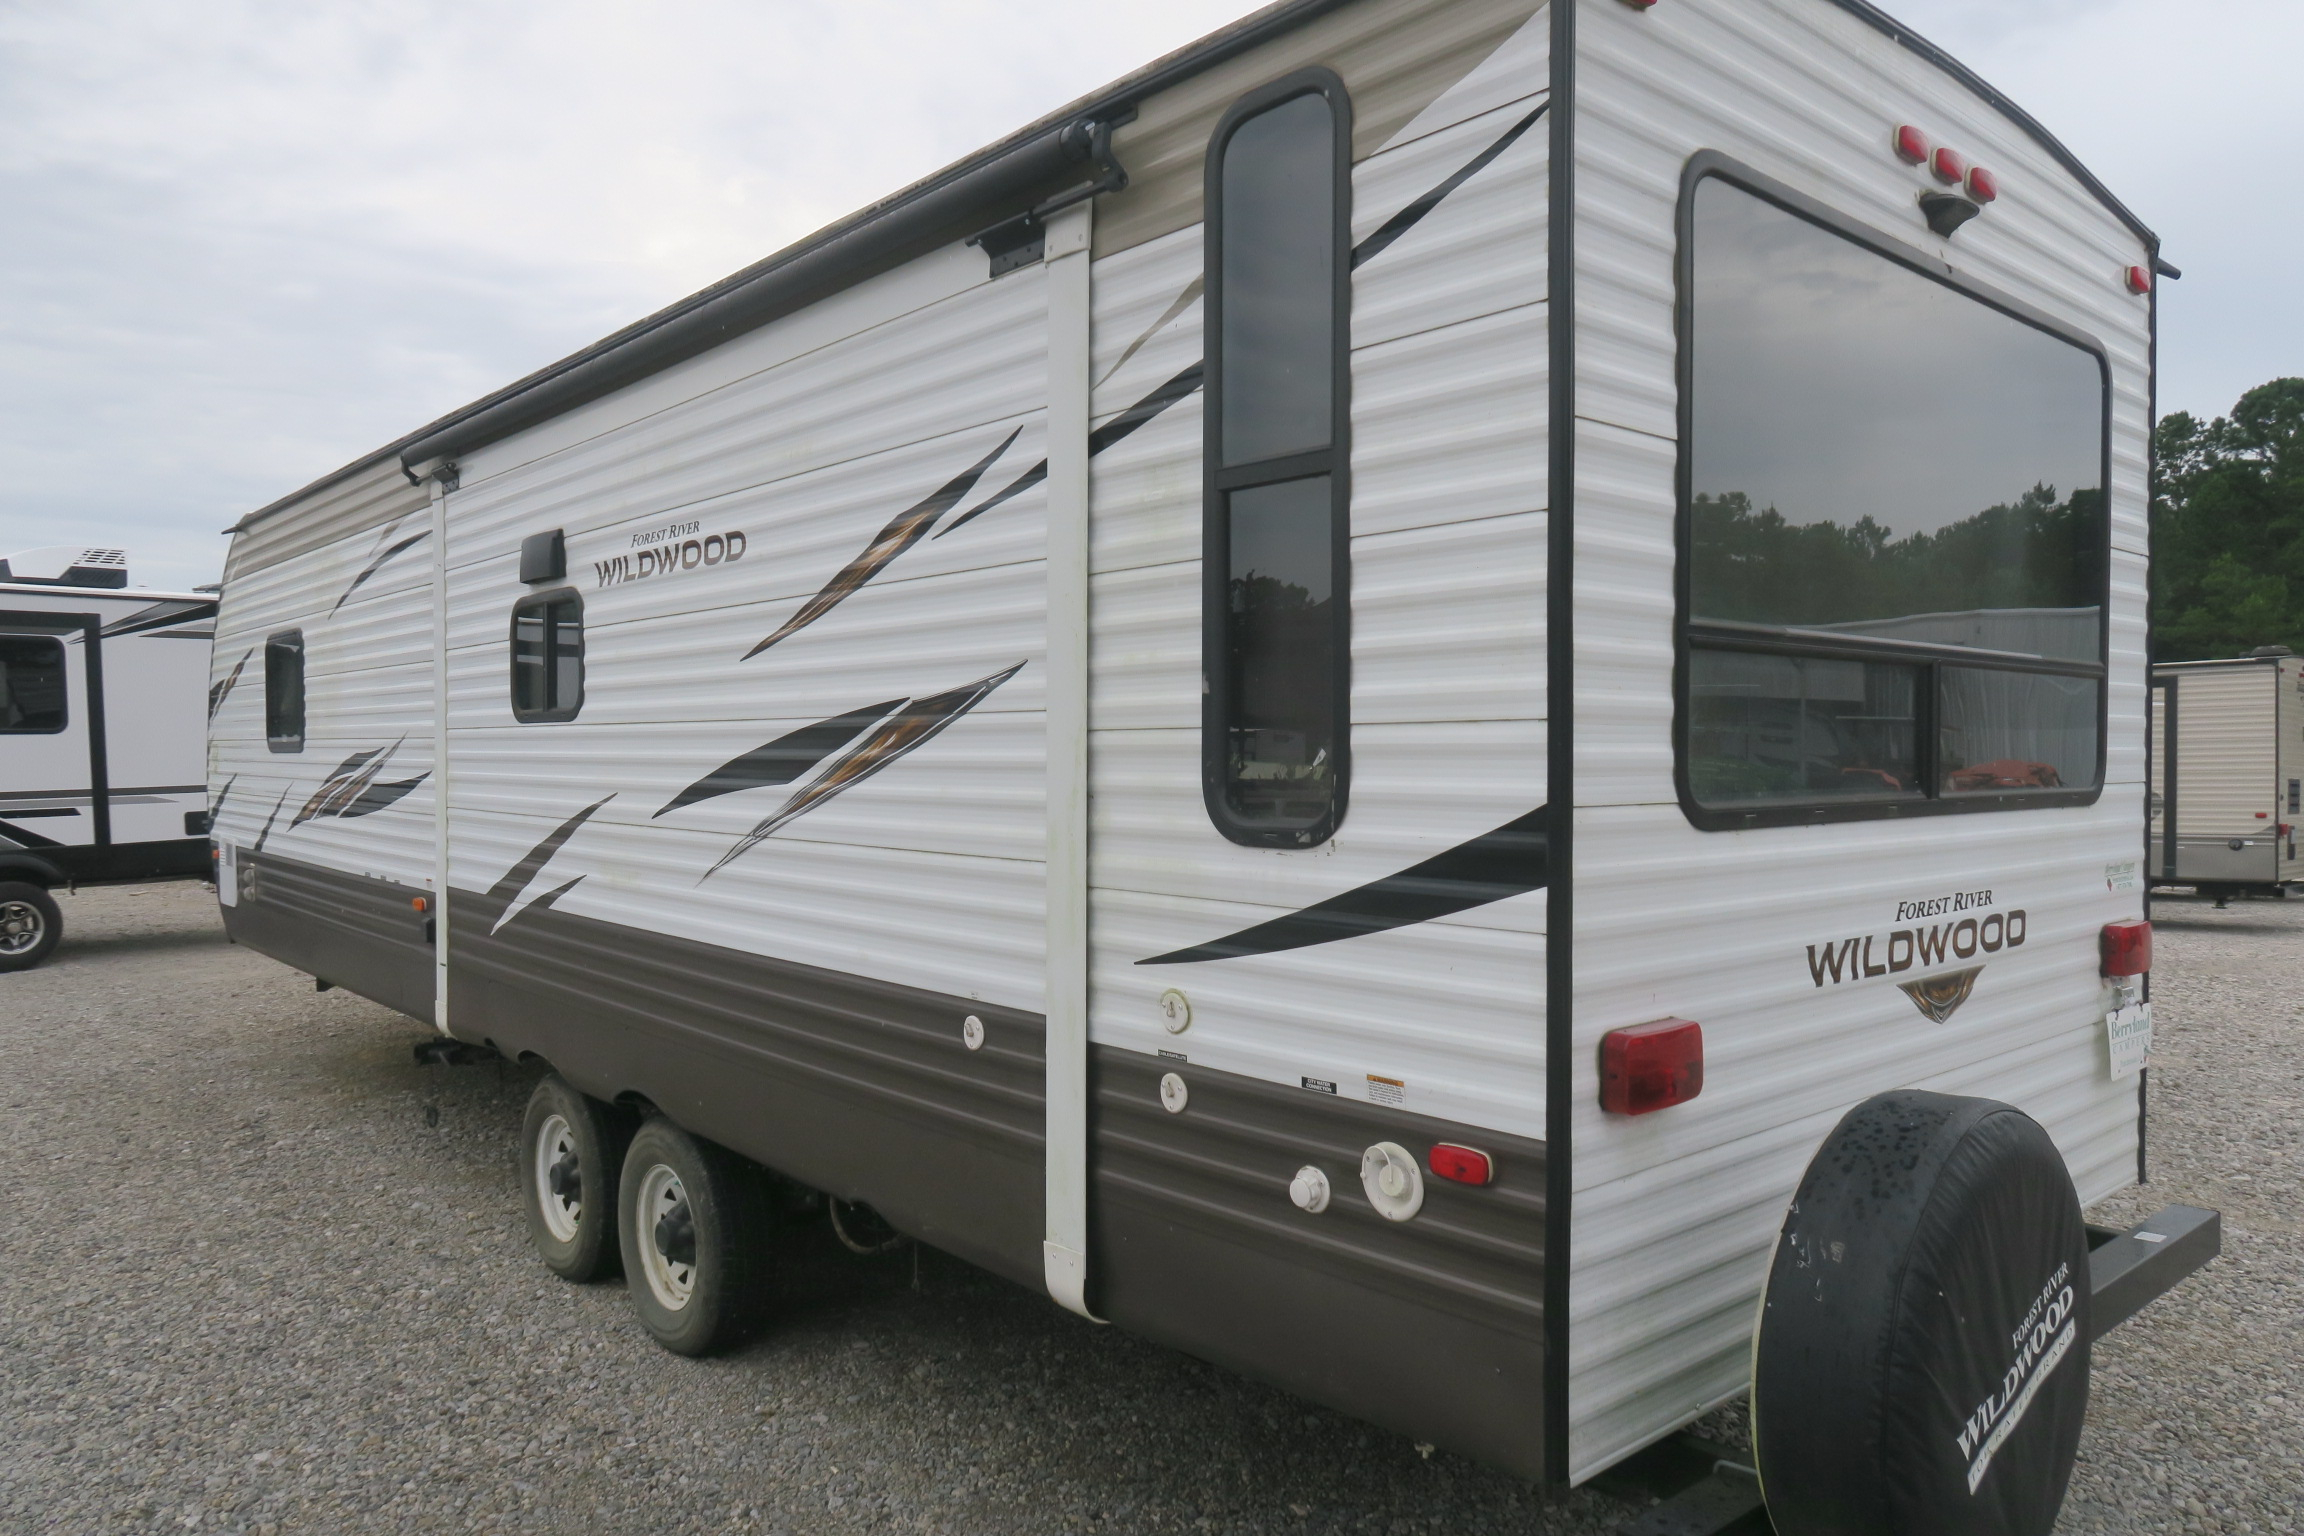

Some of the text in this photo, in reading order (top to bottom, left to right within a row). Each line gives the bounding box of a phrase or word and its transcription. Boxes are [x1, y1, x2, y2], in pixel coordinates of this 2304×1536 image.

[594, 530, 747, 588] WILDWOOD
[631, 520, 700, 548] FOREST RIVER
[1895, 889, 1993, 922] FOREST RIVER
[1805, 909, 2027, 988] WILDWOOD
[2012, 1261, 2069, 1350] FOREST RIVER
[1956, 1284, 2074, 1462] WILDWOOD
[2035, 1326, 2074, 1382] BRAND
